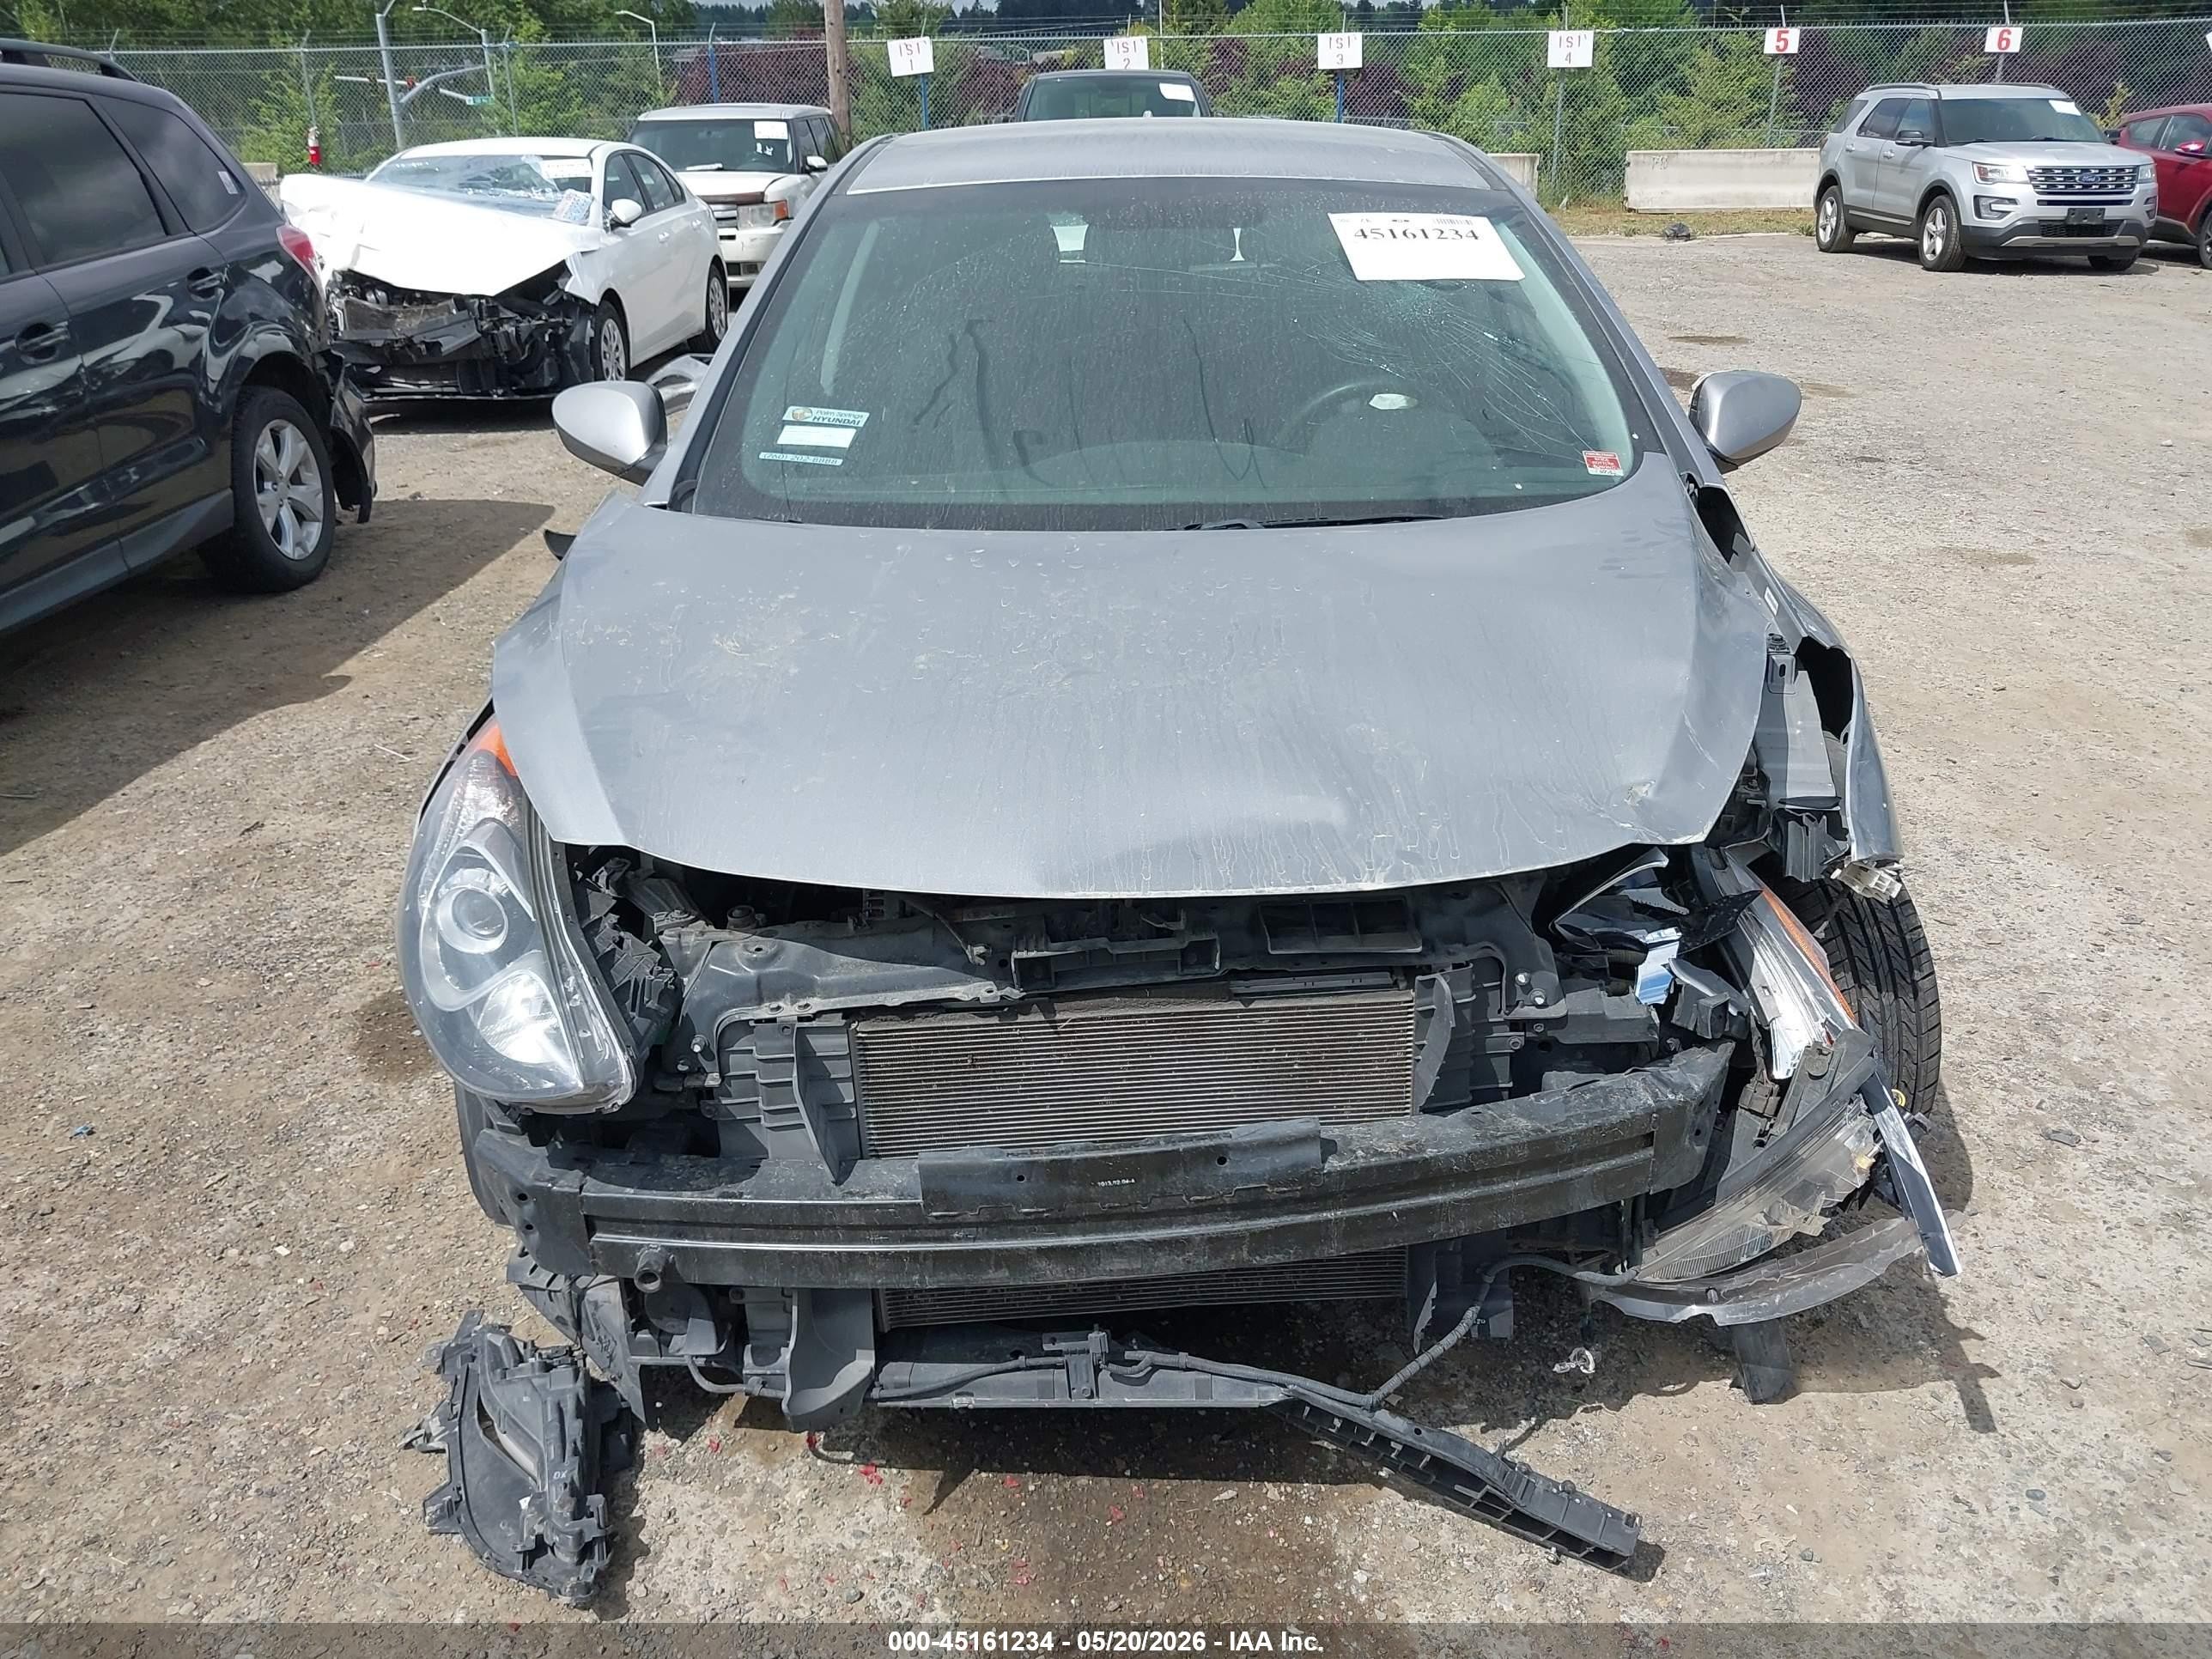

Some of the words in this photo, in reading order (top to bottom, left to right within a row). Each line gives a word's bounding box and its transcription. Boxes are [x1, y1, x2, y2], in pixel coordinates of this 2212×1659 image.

[1775, 29, 1790, 52] 5
[1997, 28, 2012, 51] 6
[1336, 53, 1344, 65] 3
[1565, 51, 1571, 64] 4
[1353, 227, 1480, 241] 45161234
[812, 416, 861, 426] HYUNDAI
